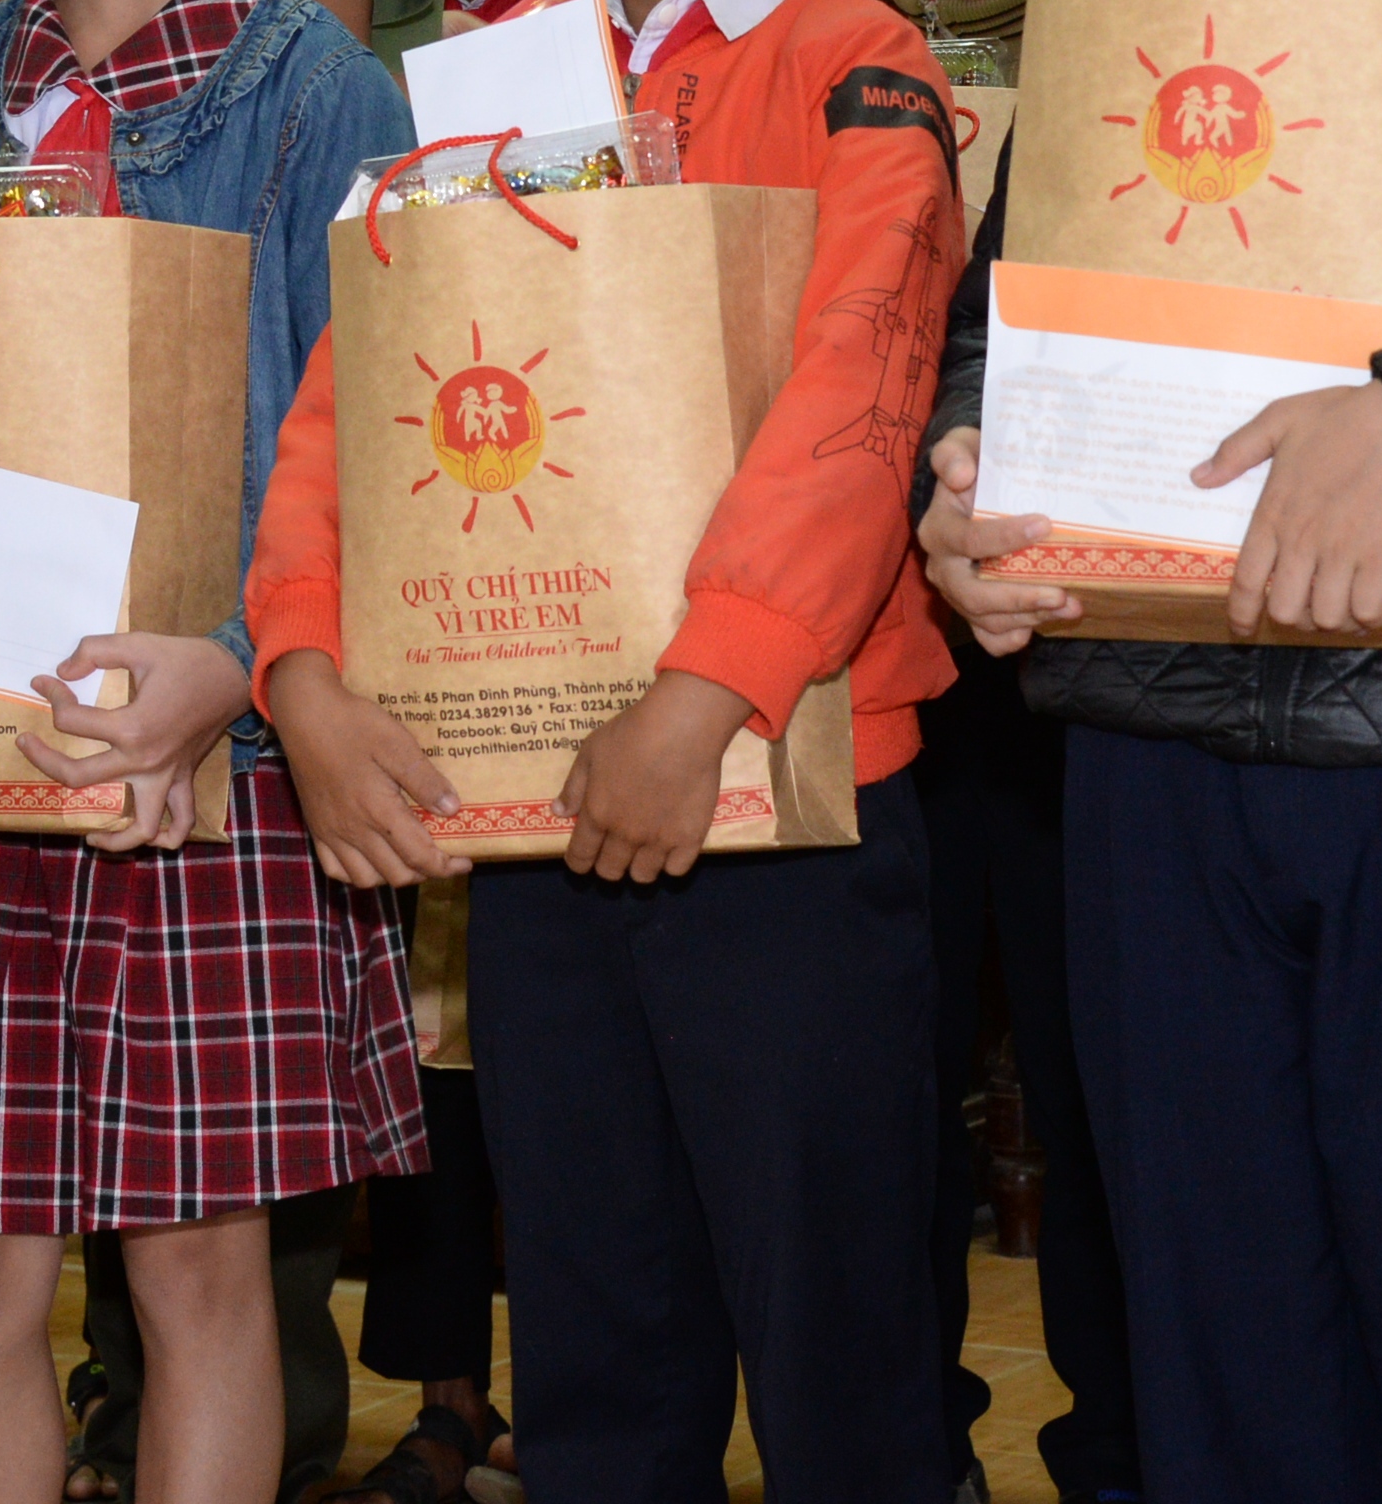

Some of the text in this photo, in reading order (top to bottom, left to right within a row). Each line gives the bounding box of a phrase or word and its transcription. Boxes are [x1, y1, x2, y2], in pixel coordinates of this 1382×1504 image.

[401, 561, 612, 608] QUỸ CHÍ THIỆN
[434, 597, 583, 634] VÌ TRẺ EM
[405, 636, 622, 664] Chi Thien Children's Fund
[378, 693, 397, 707] Địa
[400, 691, 421, 704] chỉ:
[424, 692, 438, 703] 45
[441, 691, 475, 703] Phan
[479, 688, 509, 701] Đình
[513, 684, 561, 699] Phùng,
[564, 682, 605, 695] Thành
[609, 677, 634, 694] phố
[404, 709, 436, 725] thoại:
[439, 704, 533, 721] 0234.3829136
[549, 702, 577, 714] Fax:
[437, 725, 506, 739] Facebook:
[510, 721, 538, 736] Quỹ
[542, 718, 566, 732] Chí
